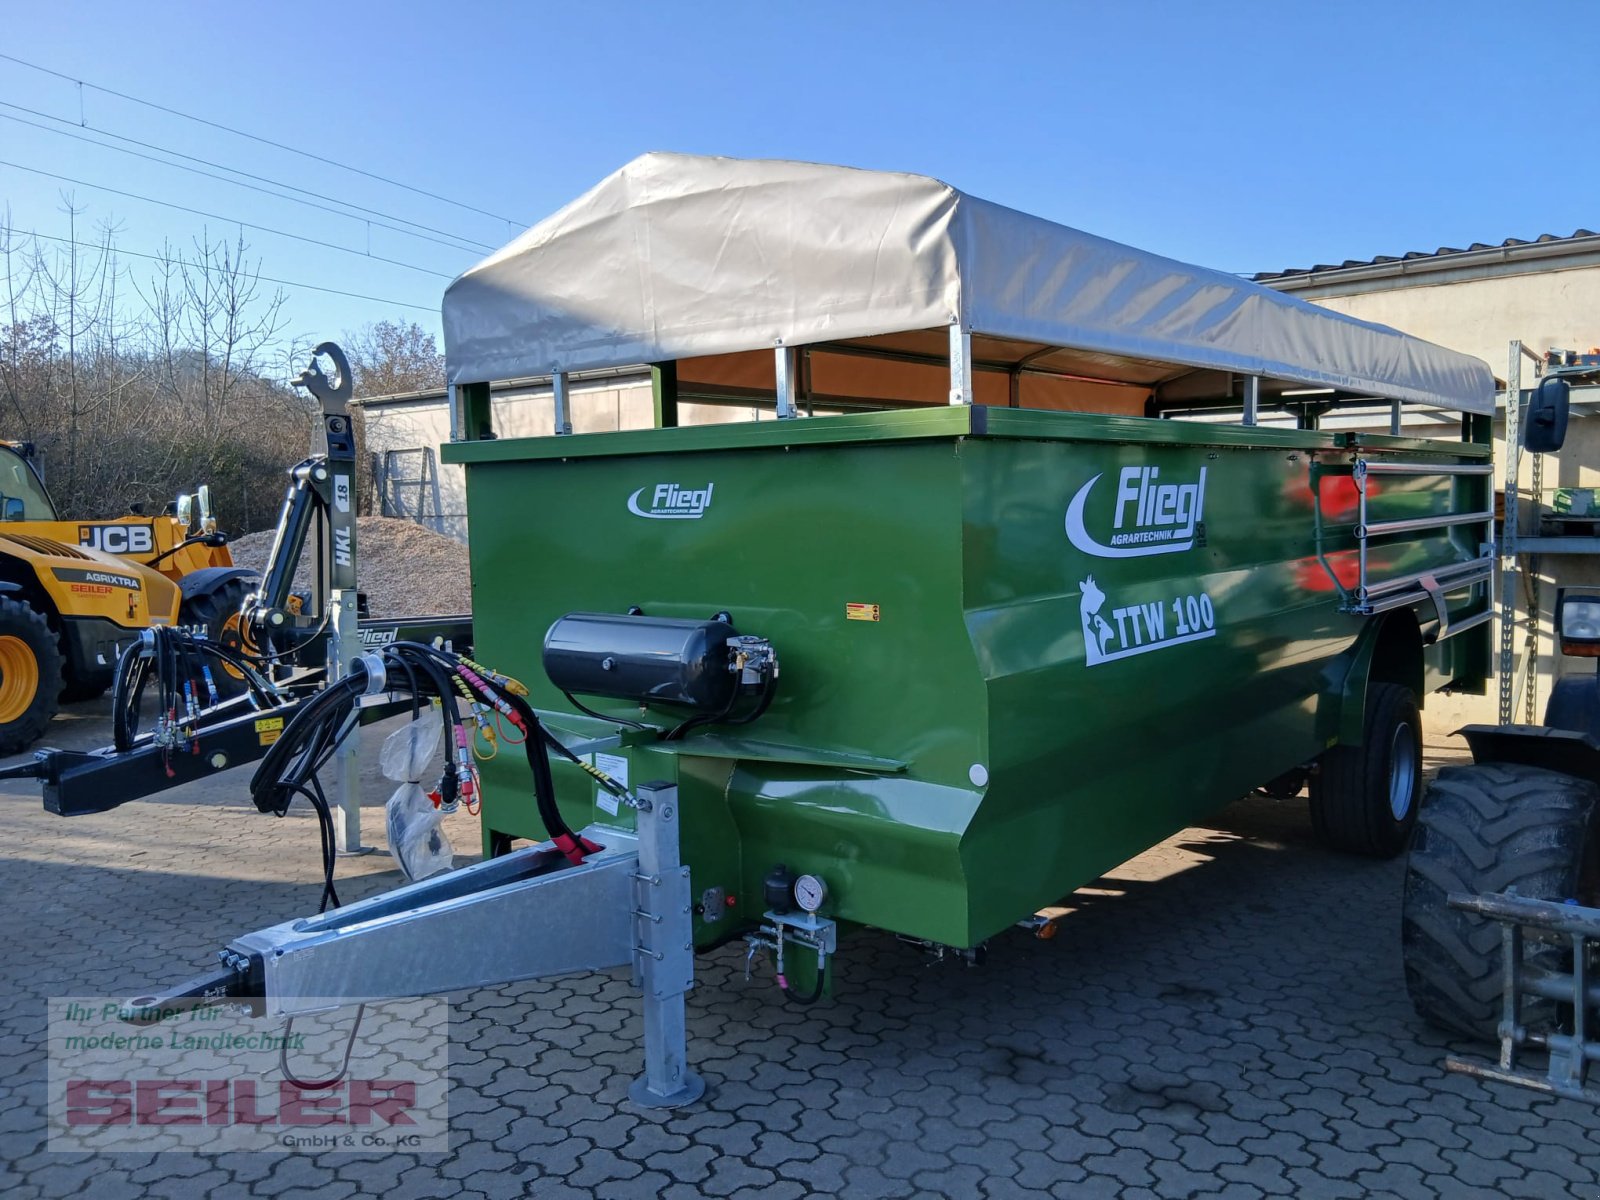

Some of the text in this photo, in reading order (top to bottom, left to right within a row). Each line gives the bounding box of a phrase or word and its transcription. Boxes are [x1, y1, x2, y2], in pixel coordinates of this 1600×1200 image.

[337, 485, 348, 502] 18
[652, 482, 714, 513] Fliegl
[1114, 466, 1207, 539] Fliegl
[80, 526, 153, 553] JCB
[335, 526, 351, 566] HKL
[1110, 529, 1174, 546] AGRARTECHNIK
[71, 584, 113, 594] SEILER
[85, 572, 139, 589] AGRIXTRA
[1112, 592, 1214, 649] TTW 100
